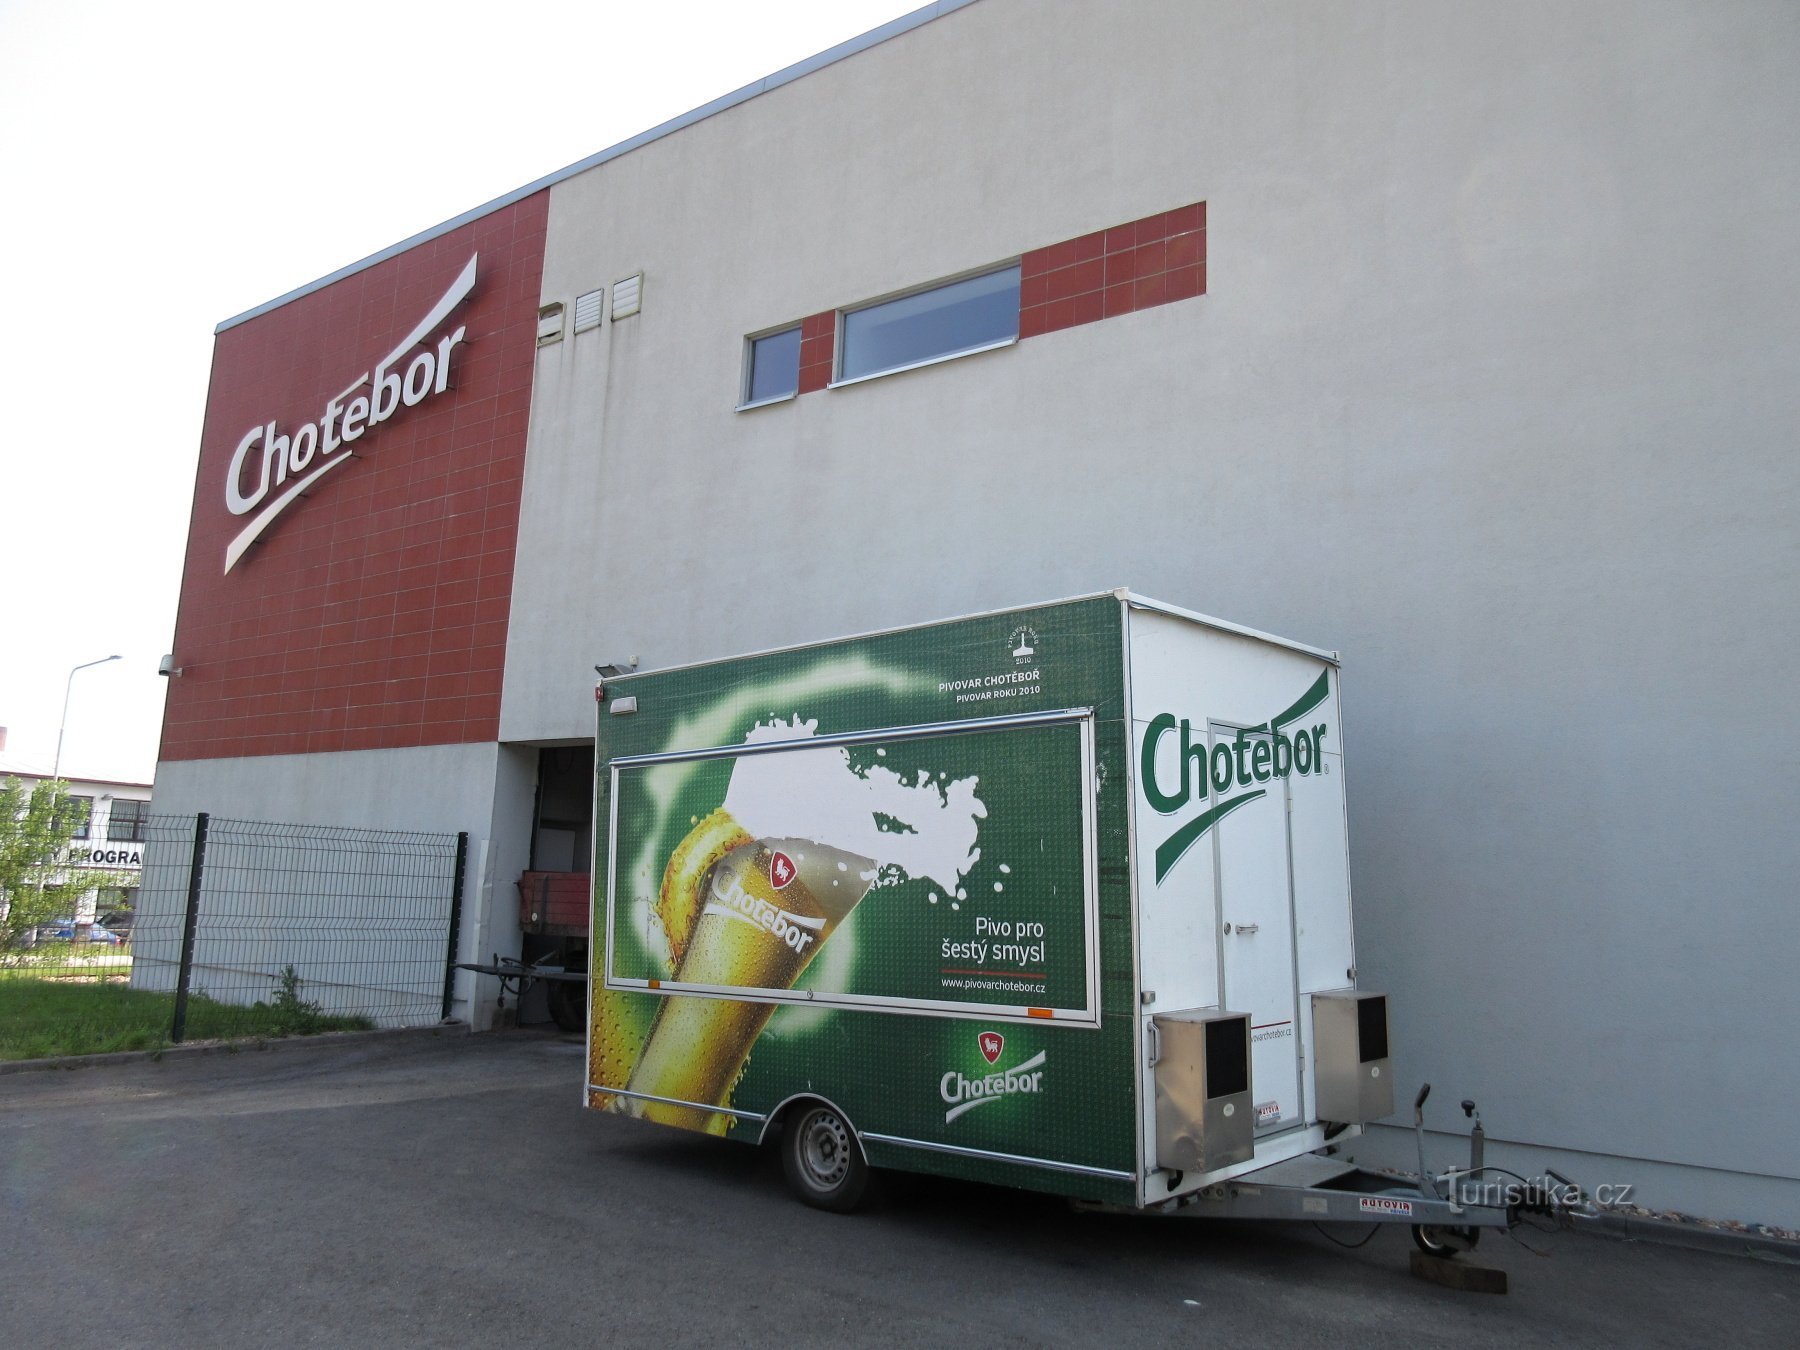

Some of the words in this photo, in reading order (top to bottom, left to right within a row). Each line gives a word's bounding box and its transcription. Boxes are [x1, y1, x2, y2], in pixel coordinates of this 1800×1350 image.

[1015, 656, 1031, 664] 2010
[938, 678, 982, 693] PIVOVAR
[984, 668, 1040, 686] CHOTĚBOŘ
[956, 691, 992, 703] PIVOVAR
[993, 688, 1017, 699] ROKU
[1018, 685, 1040, 696] 2010
[975, 917, 1011, 938] Pivo
[1016, 922, 1044, 941] pro
[941, 937, 988, 964] šestý
[992, 941, 1045, 967] smysl
[941, 977, 1046, 994] www.pivovarchotebor.cz
[1361, 1198, 1410, 1211] AUTOVIA
